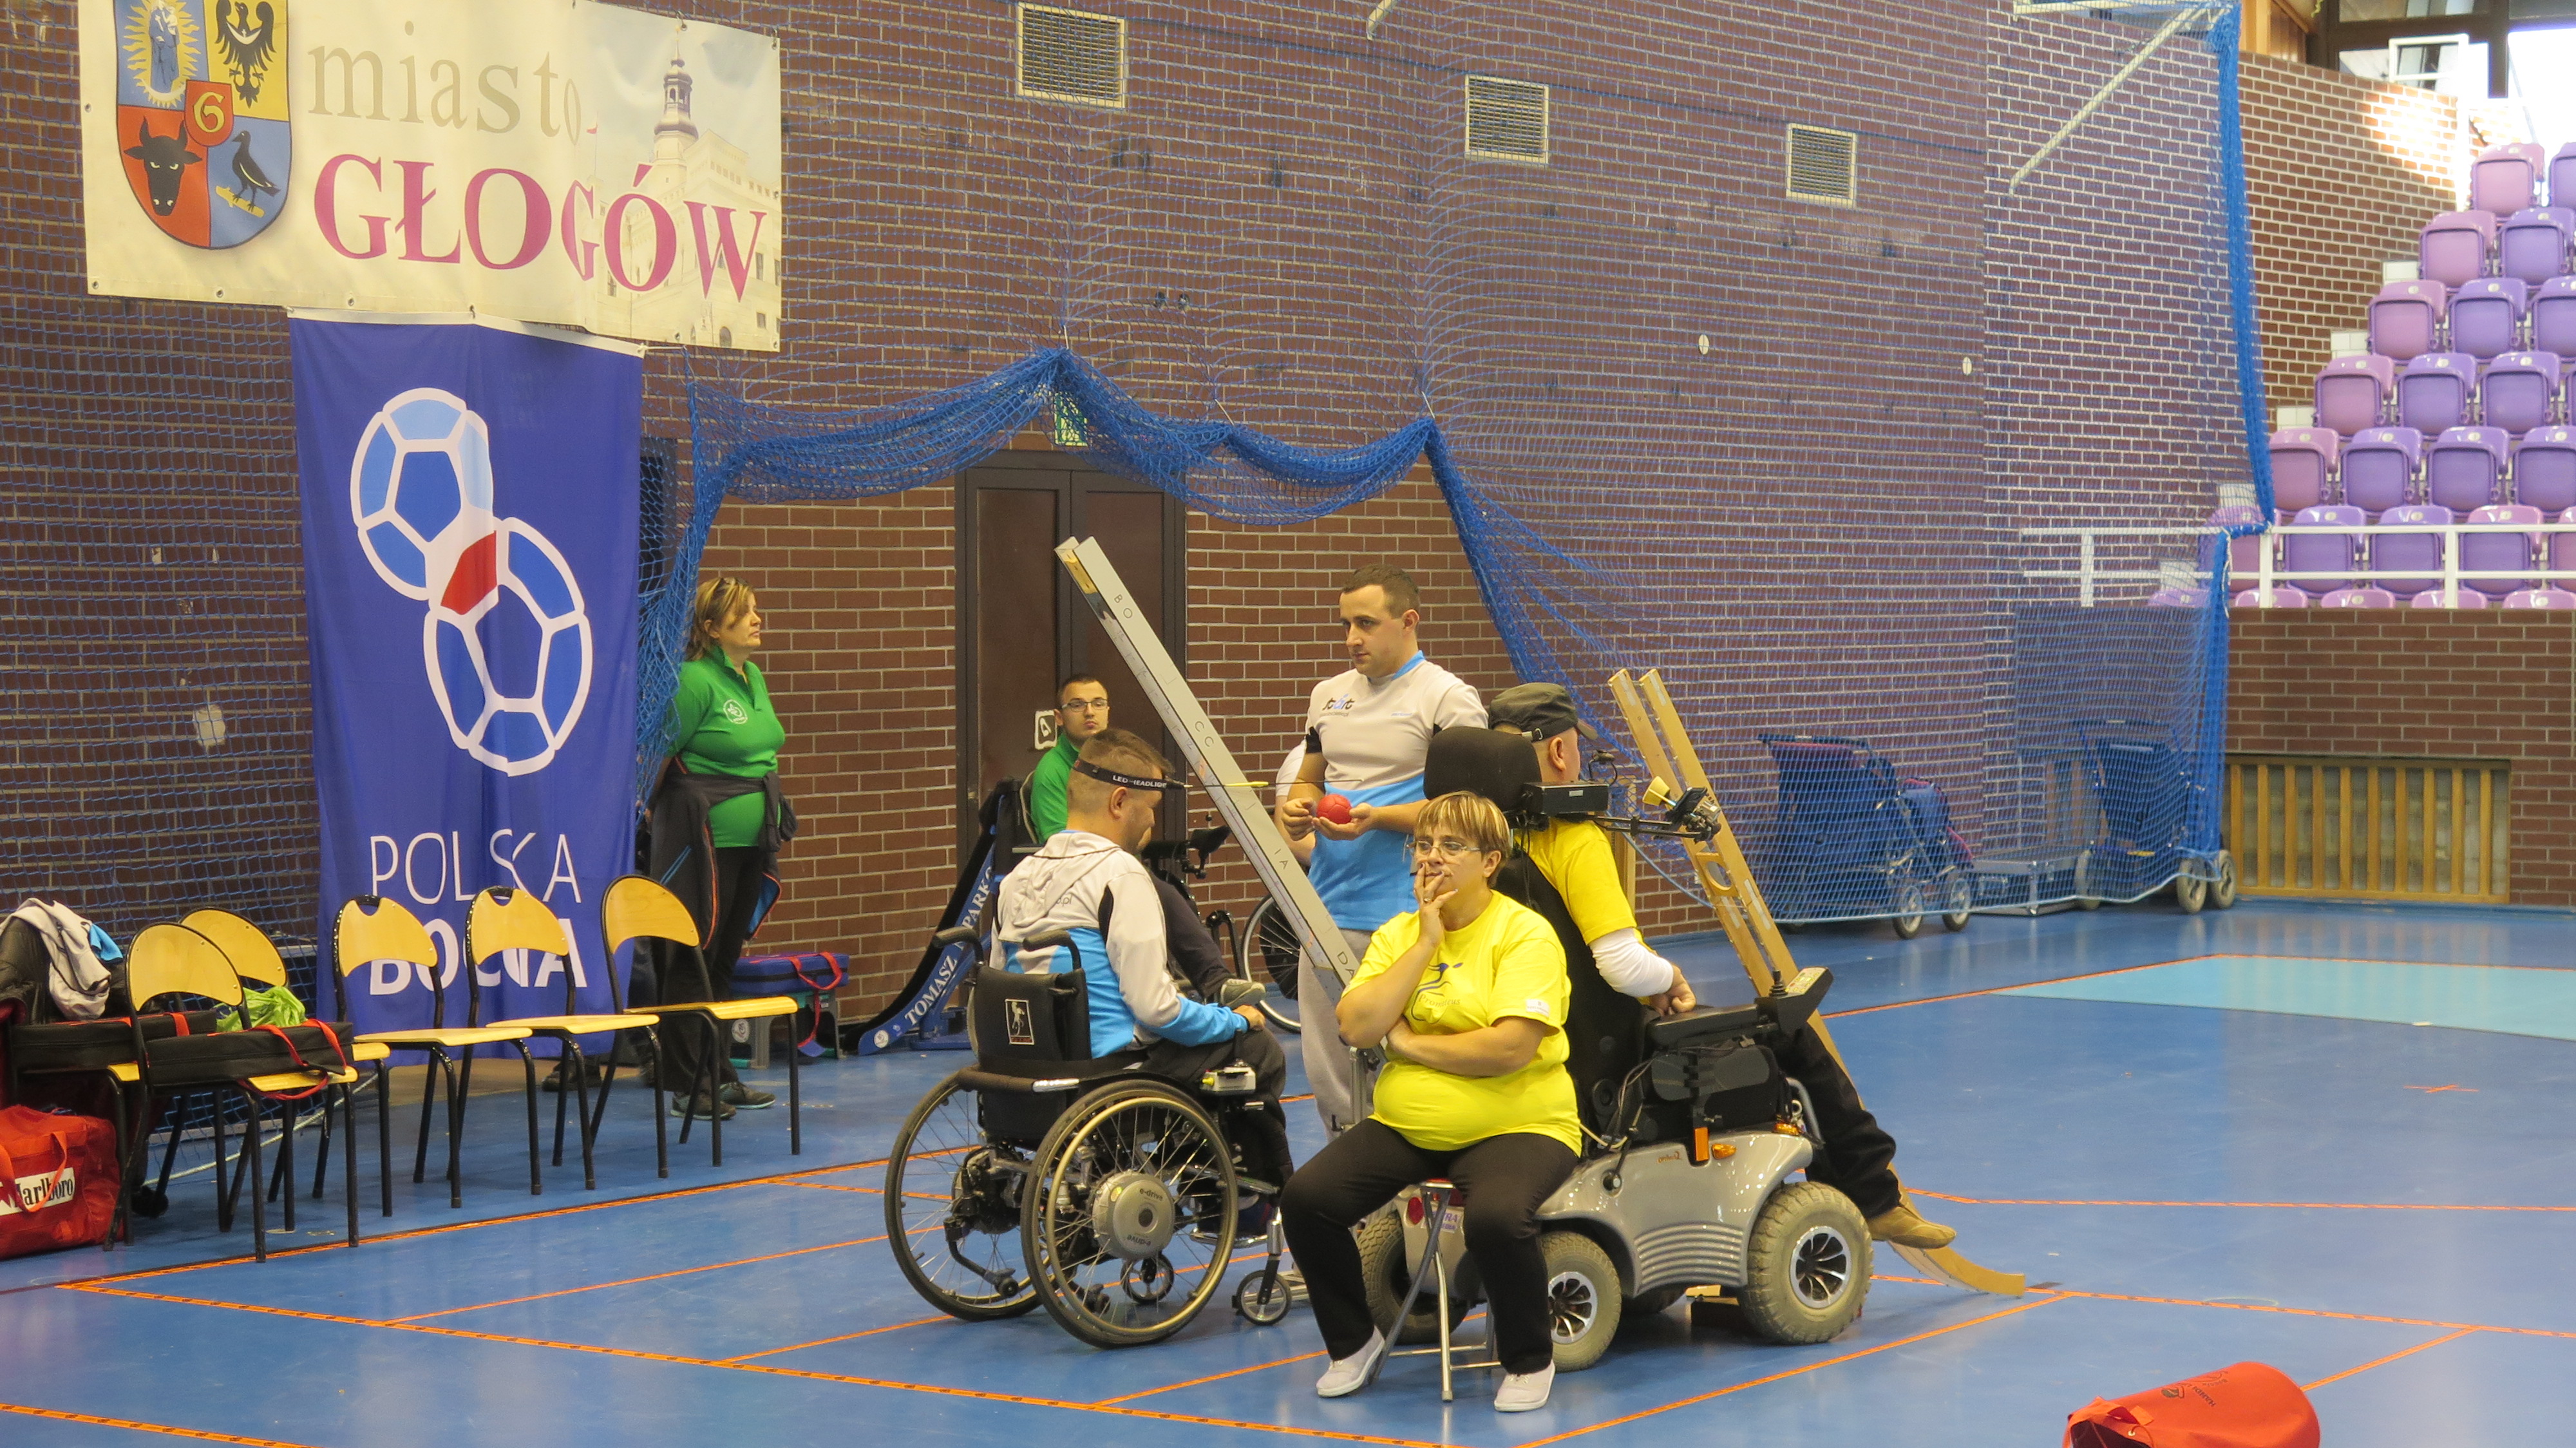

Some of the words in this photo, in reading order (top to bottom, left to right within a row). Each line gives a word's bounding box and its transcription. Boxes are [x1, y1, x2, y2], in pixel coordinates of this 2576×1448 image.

[308, 20, 582, 146] miasto
[314, 153, 767, 302] GŁOGÓW
[1112, 775, 1128, 783] LED
[370, 828, 582, 905] POLSKA
[904, 955, 958, 1026] TOMASZ
[1139, 1188, 1162, 1201] e-drive
